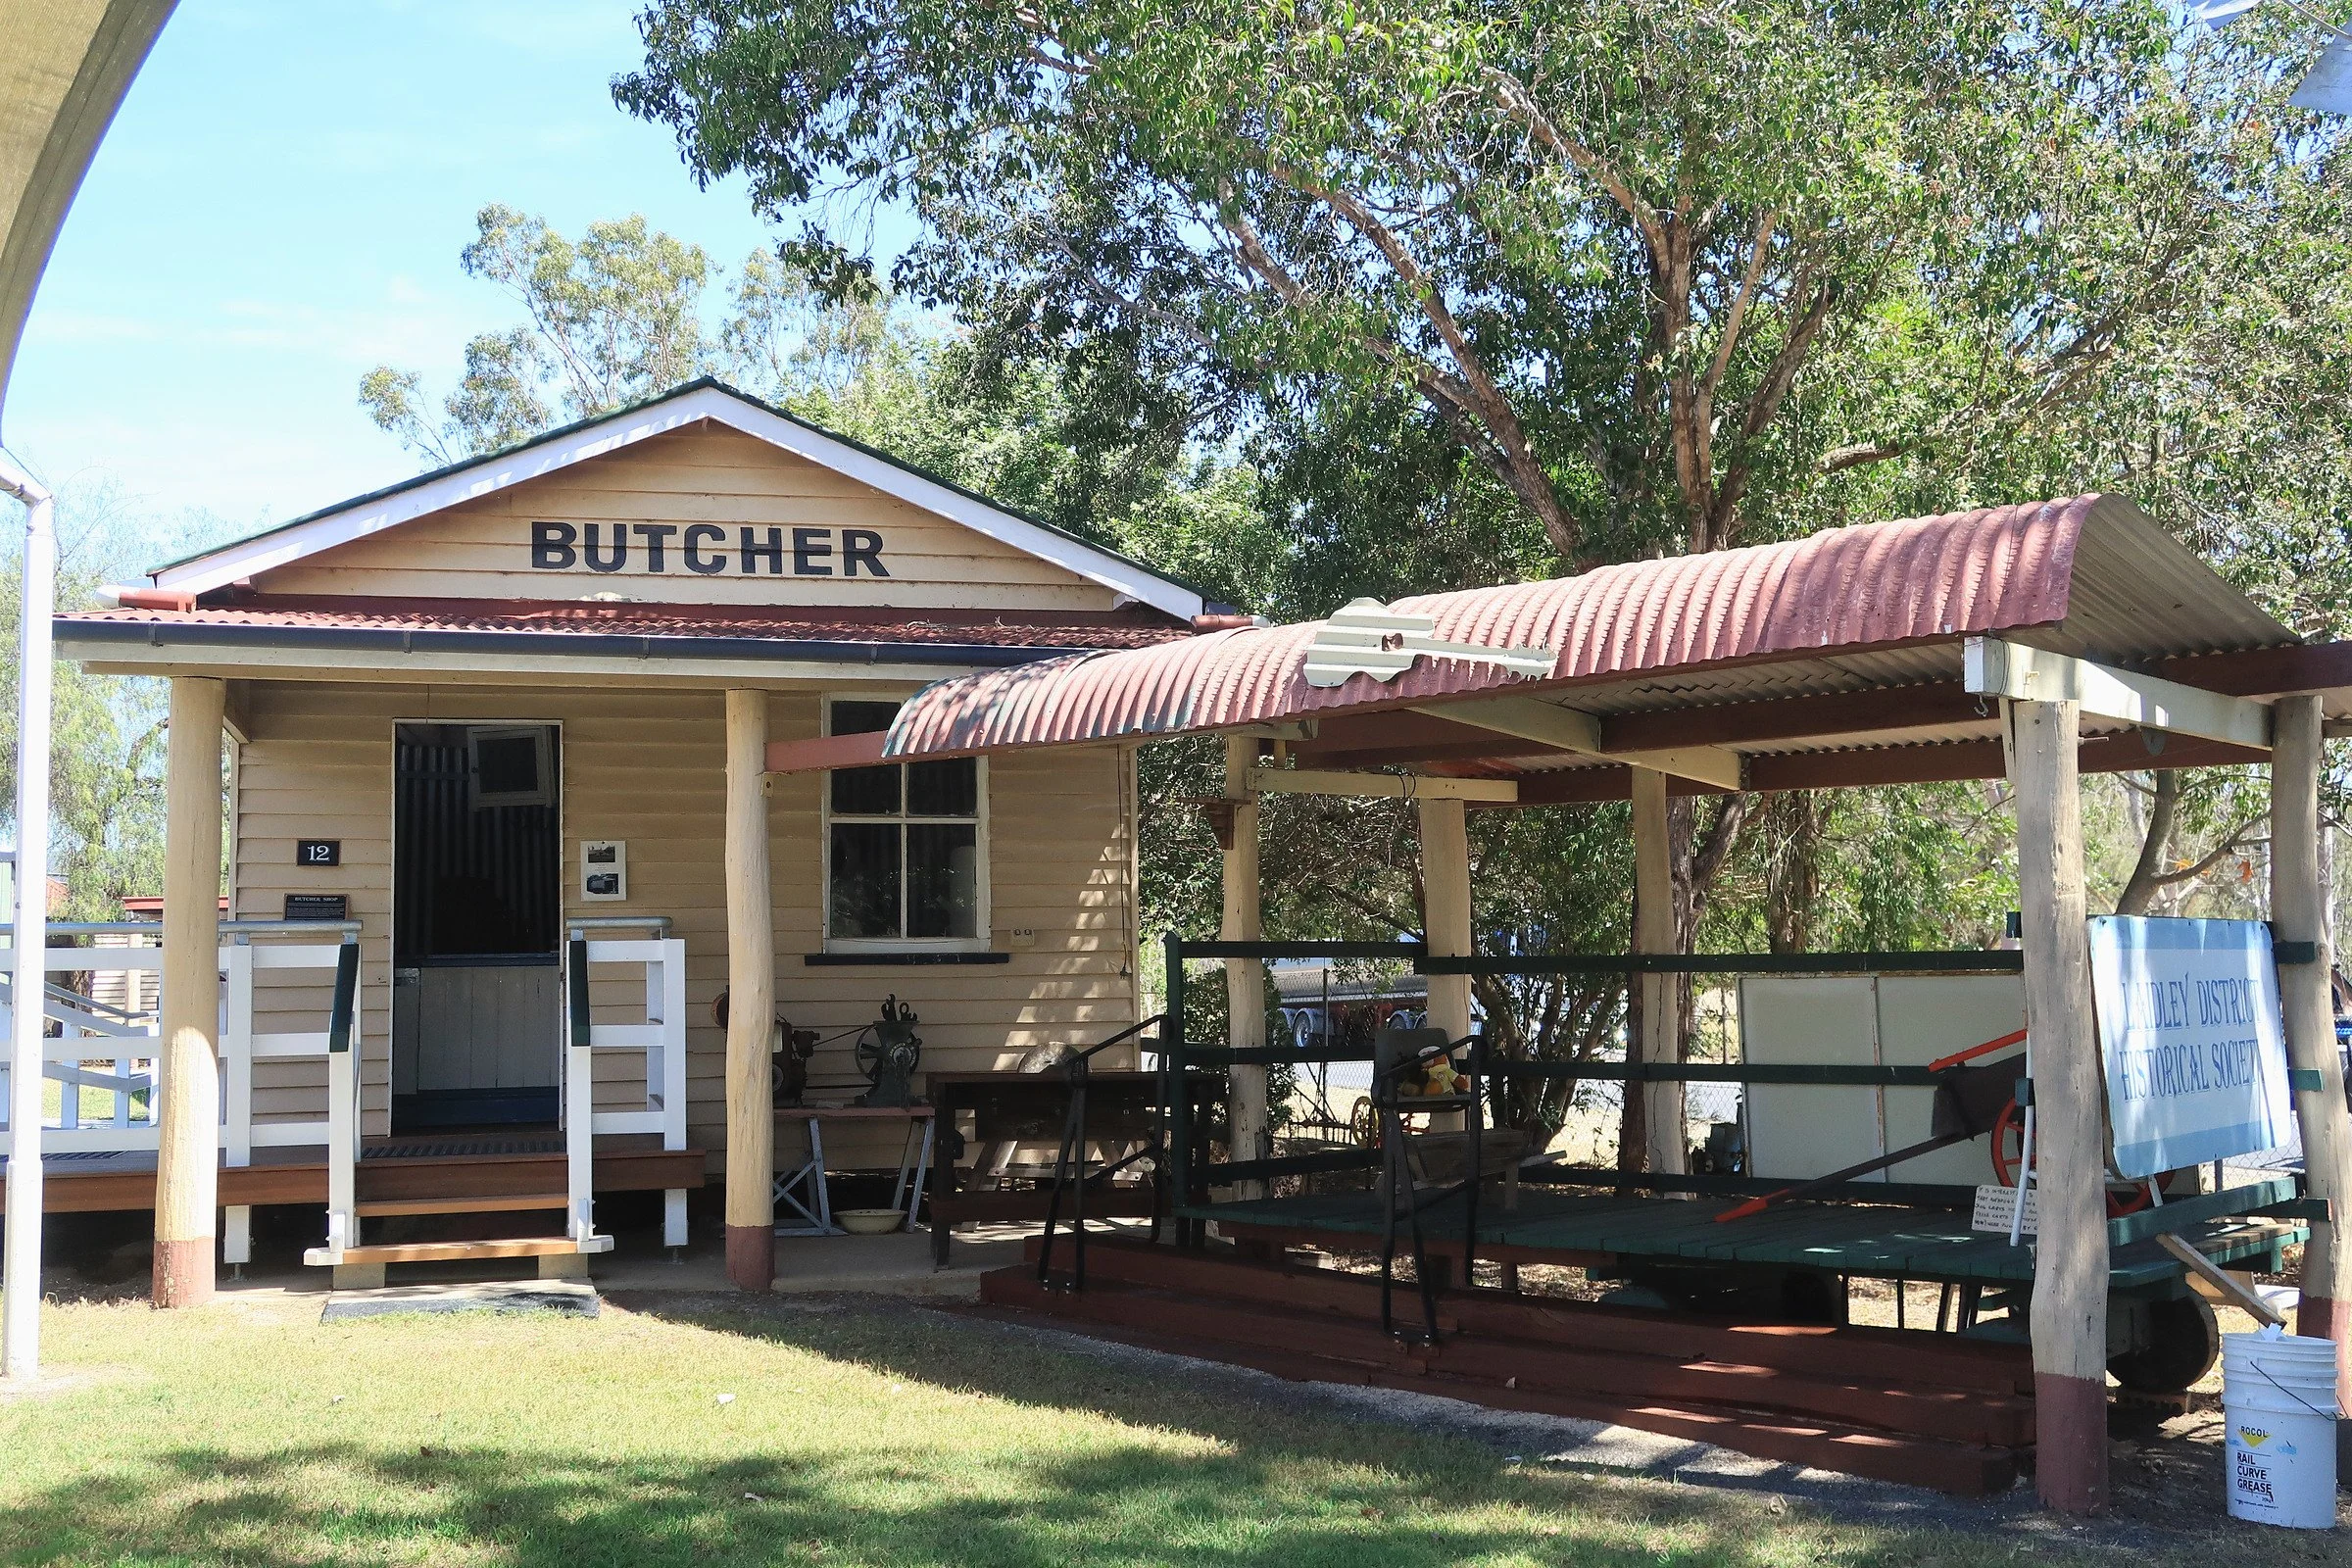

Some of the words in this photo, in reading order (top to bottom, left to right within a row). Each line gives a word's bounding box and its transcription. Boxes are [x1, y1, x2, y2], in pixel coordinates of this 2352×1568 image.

[531, 521, 890, 577] BUTCHER
[307, 845, 329, 860] 12
[2122, 972, 2191, 1031] LAIDLEY
[2196, 977, 2261, 1027] DISTRICT
[2119, 1044, 2211, 1102] HISTORICAL
[2240, 1426, 2268, 1438] ROCOL
[2236, 1452, 2256, 1465] RAIL
[2236, 1465, 2267, 1480] CURVE
[2236, 1478, 2272, 1493] GREASE
